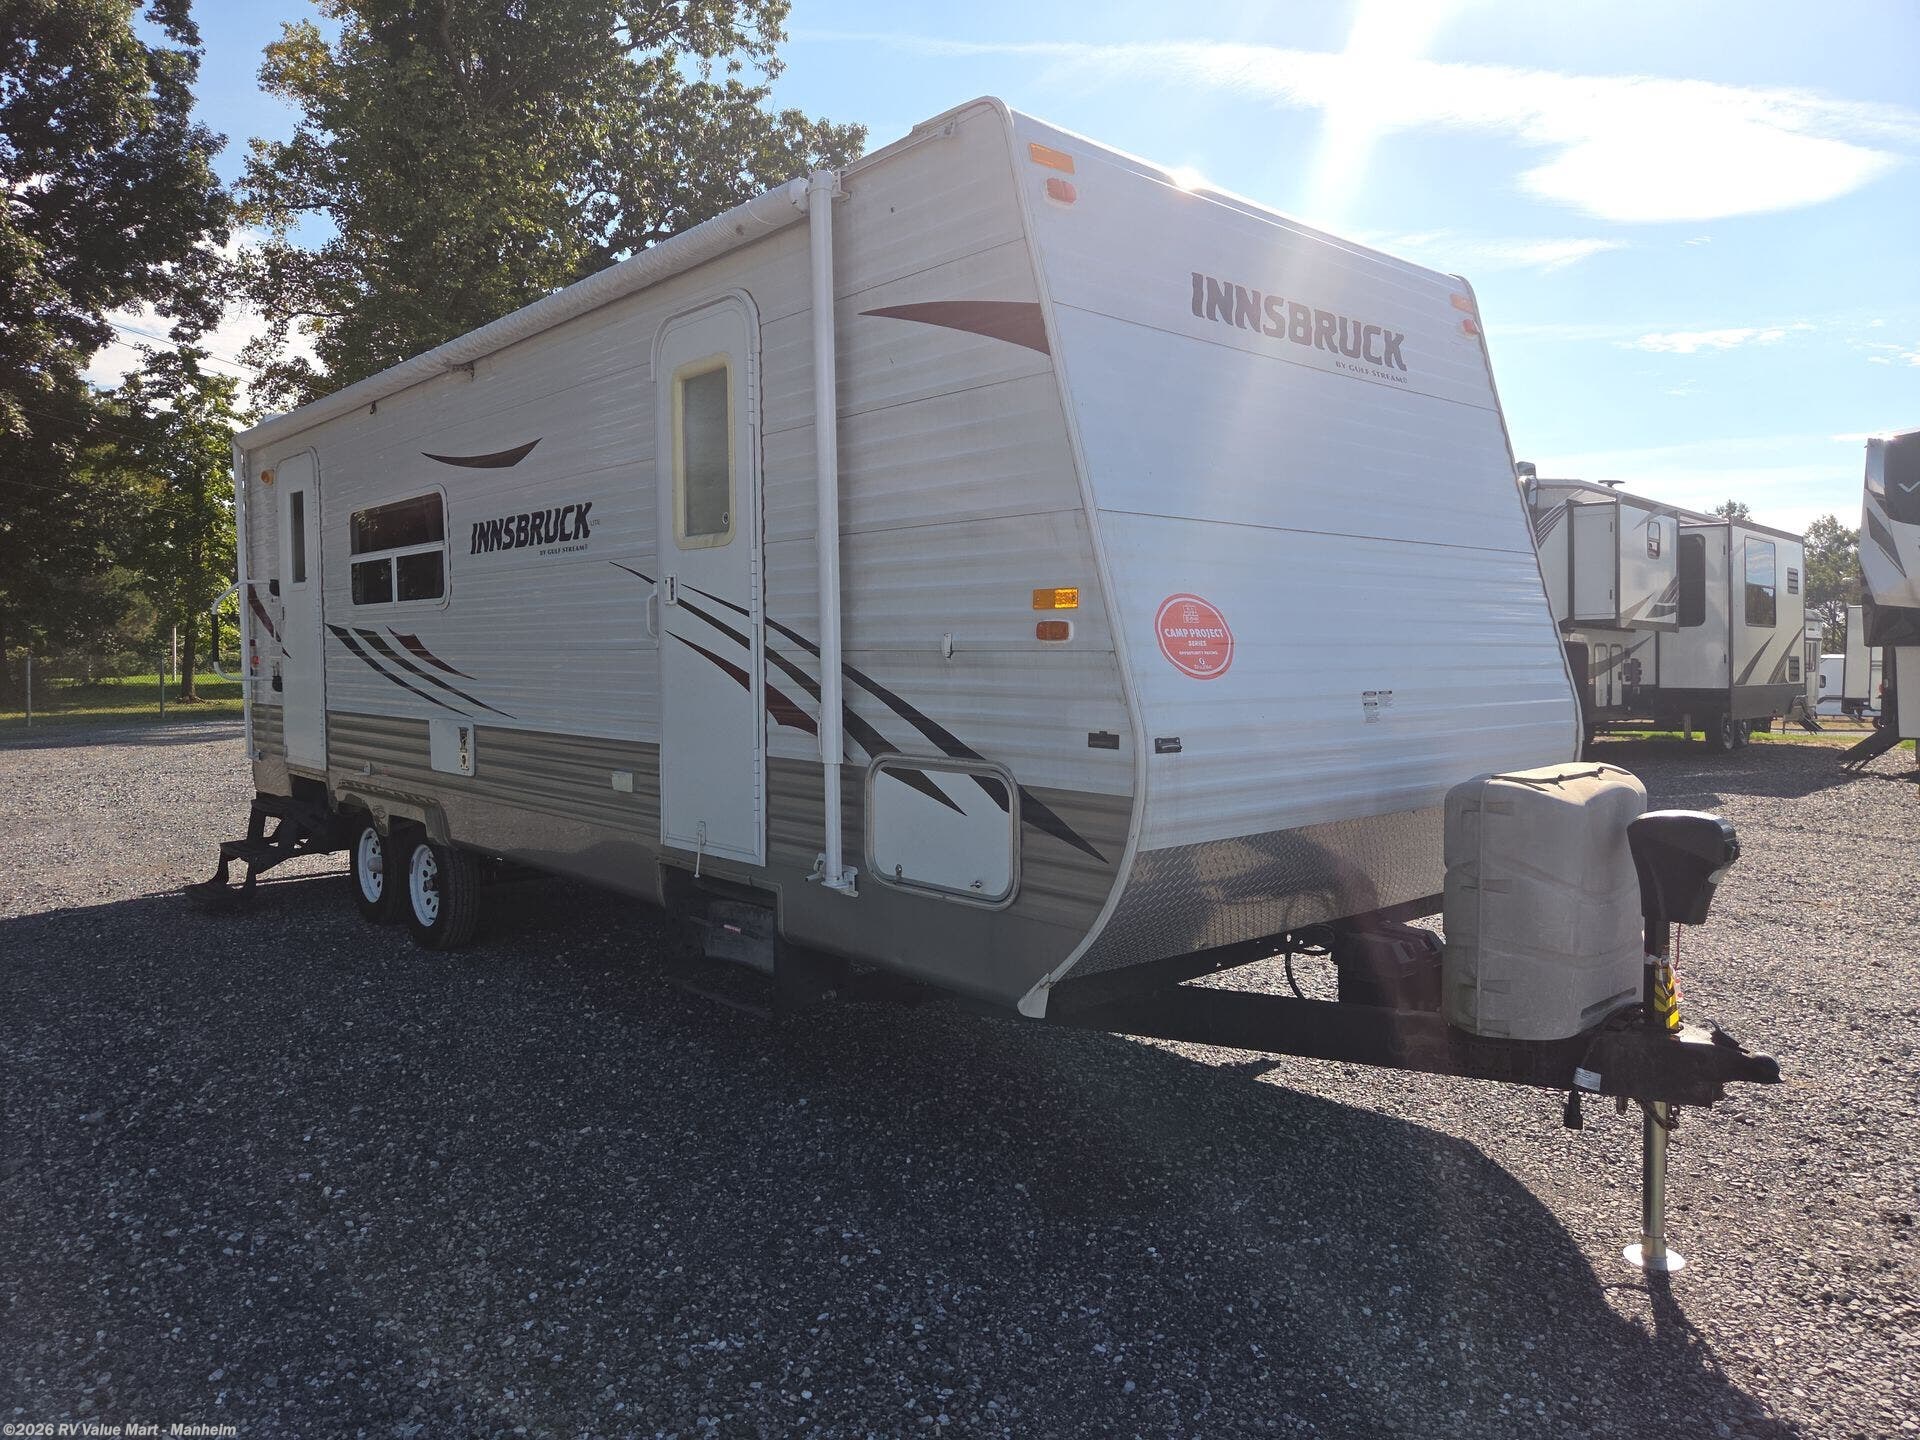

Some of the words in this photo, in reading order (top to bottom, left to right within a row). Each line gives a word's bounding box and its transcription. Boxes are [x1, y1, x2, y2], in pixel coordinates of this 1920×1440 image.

[1192, 271, 1407, 372] INNSBRUCK
[470, 501, 593, 555] INNSBRUCK
[1164, 628, 1188, 637] CAMP
[1190, 628, 1223, 638] PROJECT
